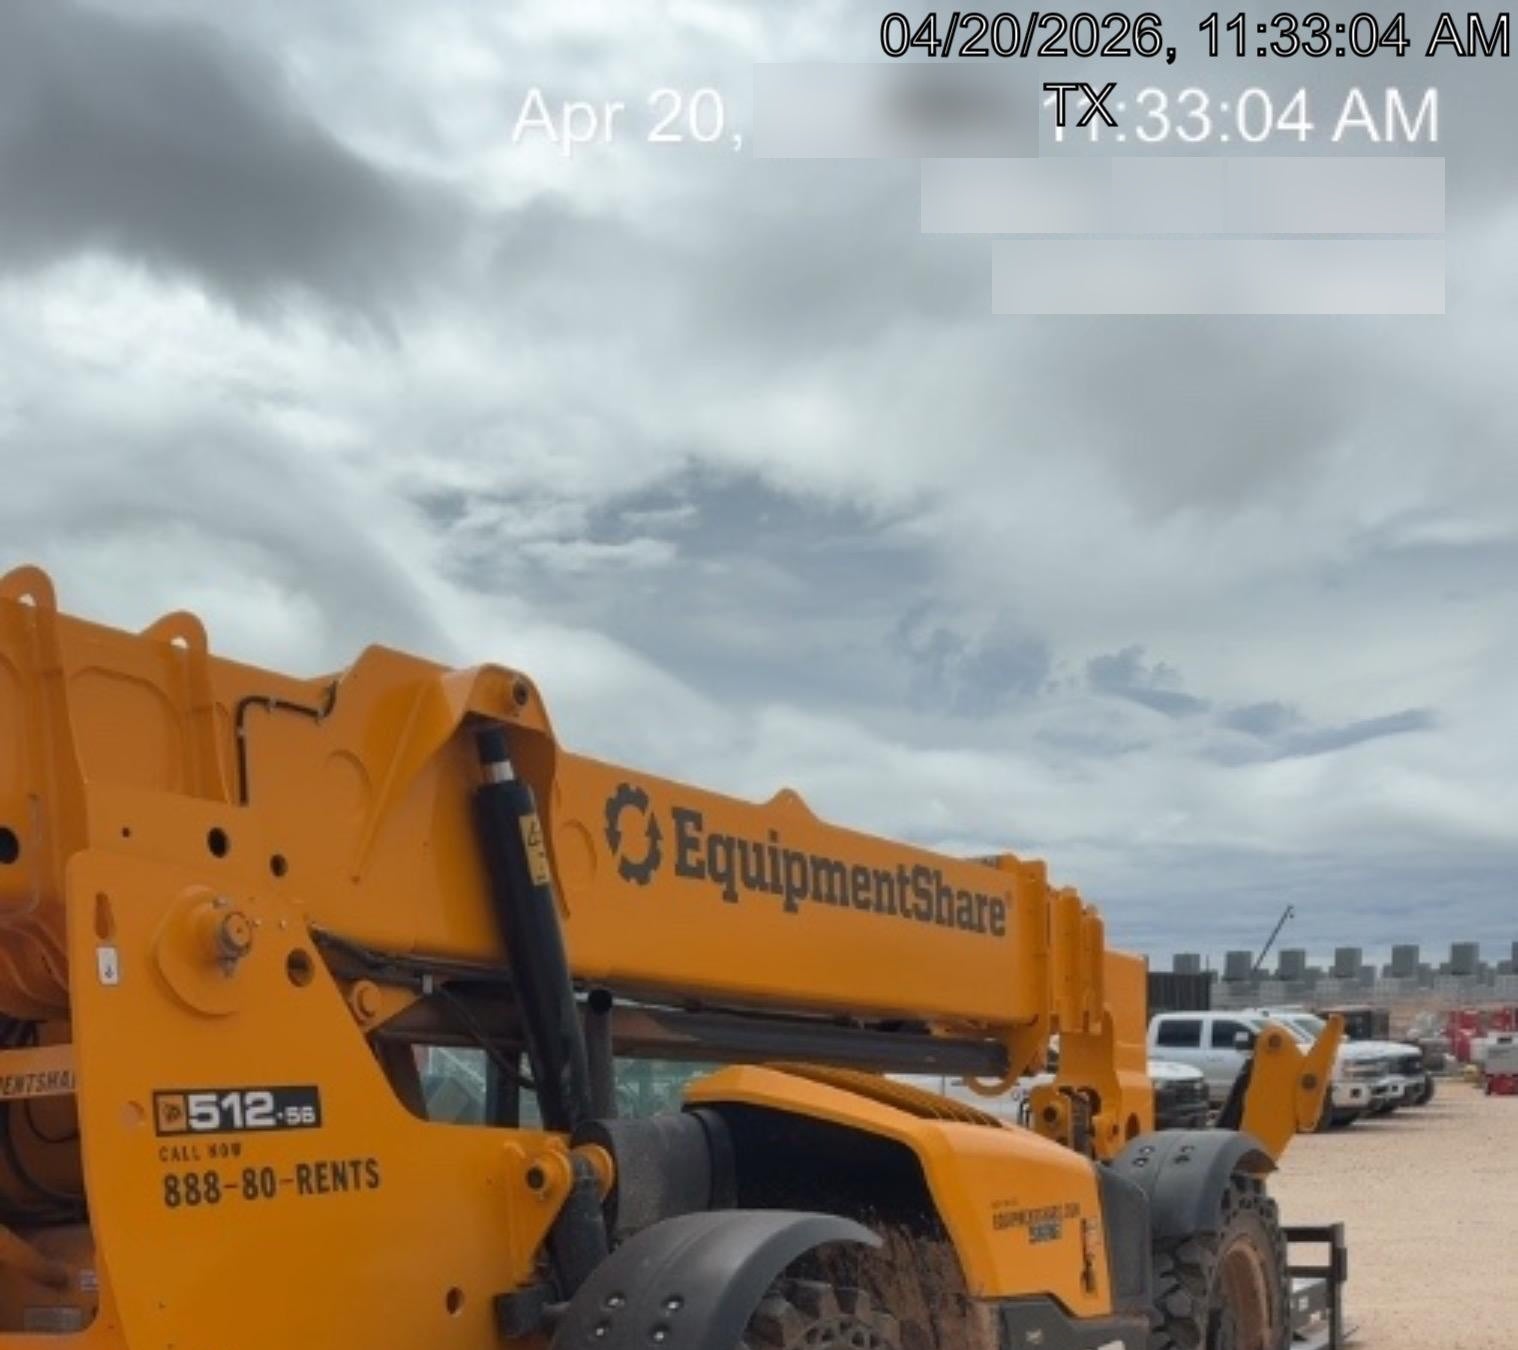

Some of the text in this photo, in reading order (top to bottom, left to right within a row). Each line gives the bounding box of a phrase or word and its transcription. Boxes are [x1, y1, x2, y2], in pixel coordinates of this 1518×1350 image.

[672, 806, 1007, 937] EquipmentShare
[158, 1142, 242, 1162] CALL NOW
[164, 1158, 380, 1208] 888-80-RENTS
